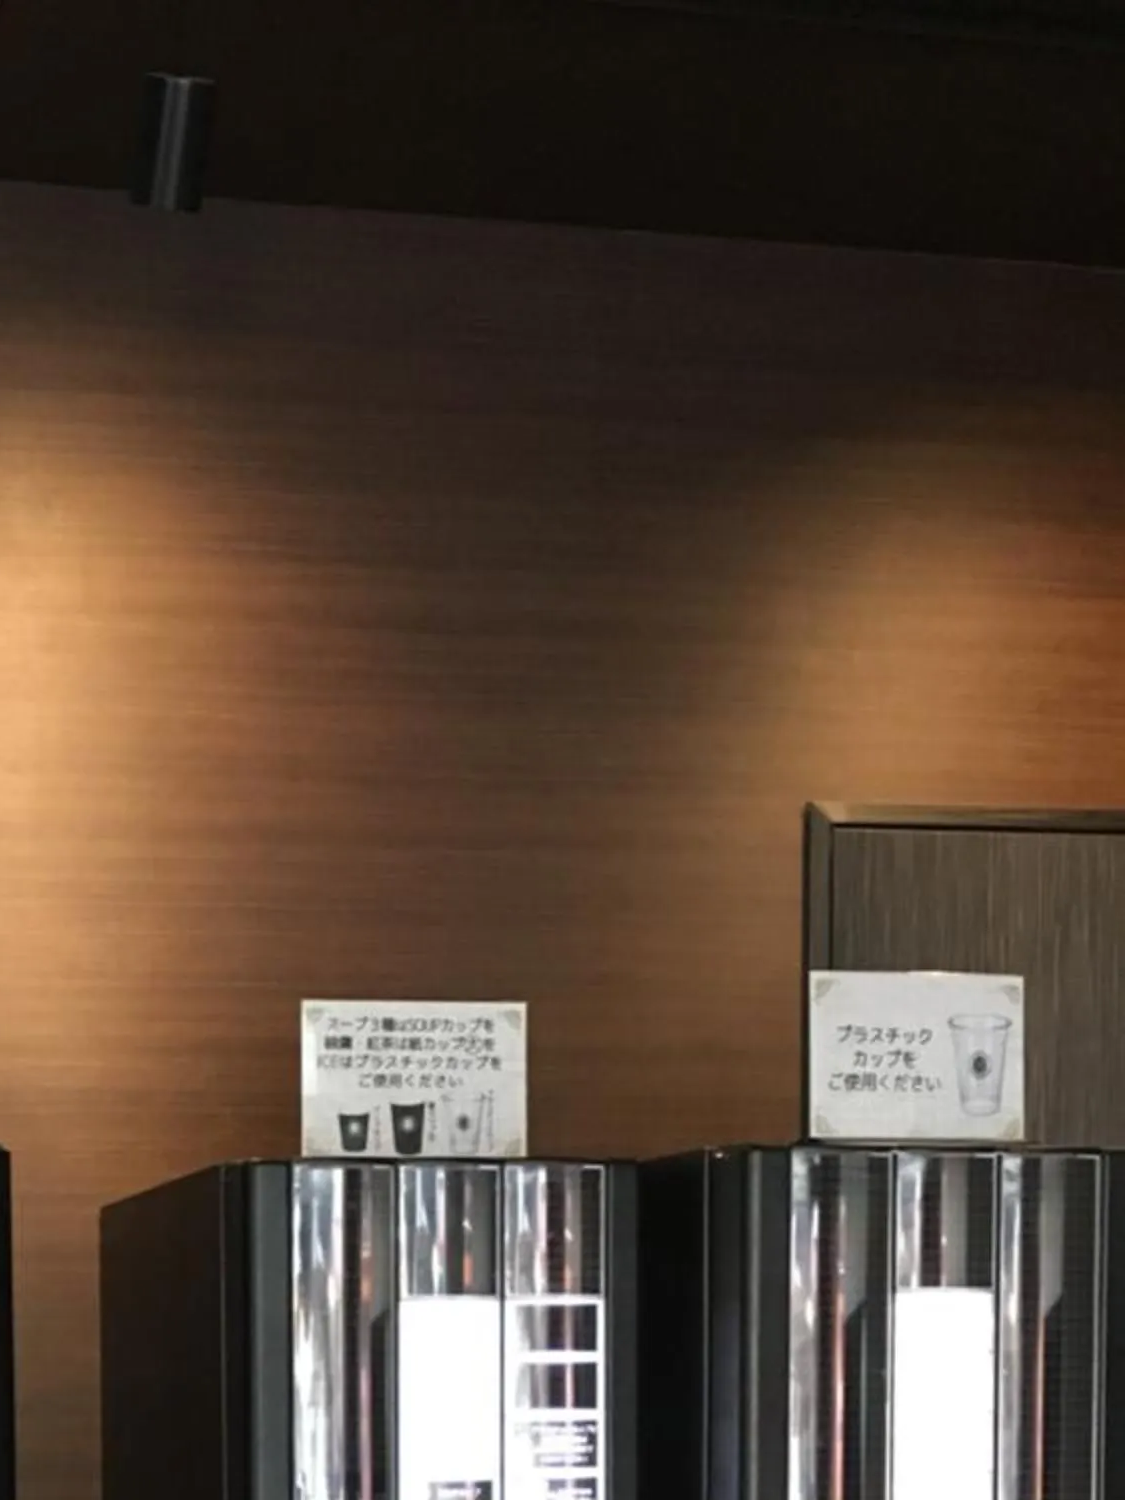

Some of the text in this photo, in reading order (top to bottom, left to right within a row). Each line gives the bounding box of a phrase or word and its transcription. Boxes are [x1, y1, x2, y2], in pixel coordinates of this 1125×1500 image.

[837, 1024, 933, 1045] プラスチック
[853, 1050, 919, 1069] カップを
[358, 1073, 464, 1089] ご使用ください
[828, 1072, 942, 1092] ご使用ください
